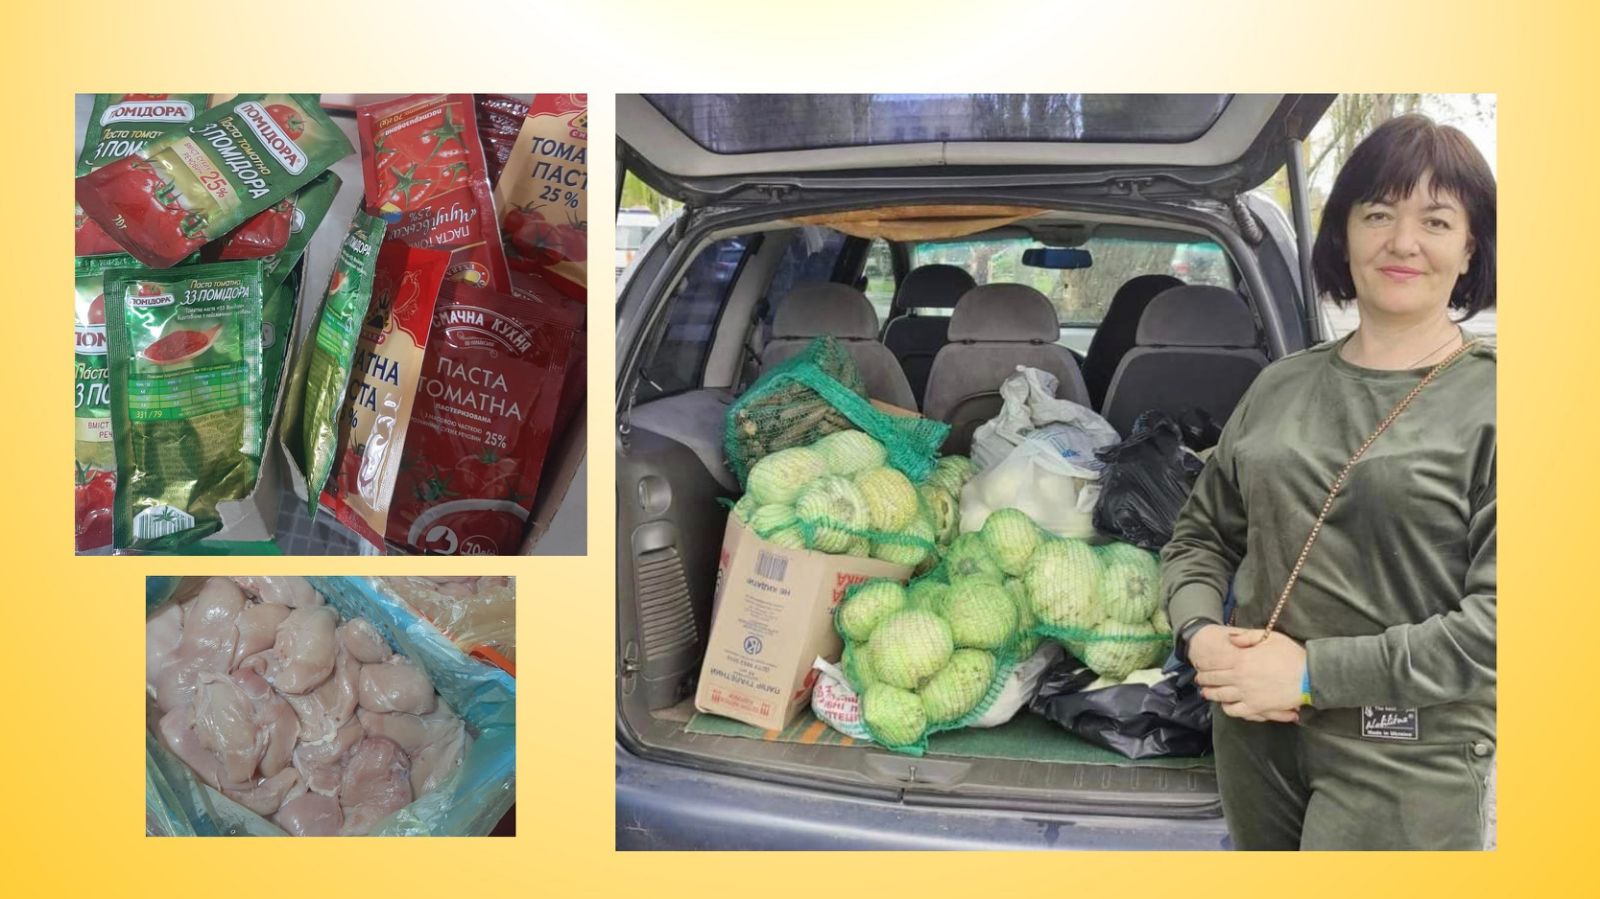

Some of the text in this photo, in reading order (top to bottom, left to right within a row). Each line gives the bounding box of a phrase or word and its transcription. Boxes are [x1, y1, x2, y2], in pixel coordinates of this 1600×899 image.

[241, 104, 299, 167] ПОМІДОРА
[202, 129, 270, 199] ПОМІДОРА
[531, 136, 587, 164] ТОМА
[200, 171, 228, 198] 25%
[539, 185, 561, 202] 25
[435, 225, 470, 244] ПАСТА
[197, 286, 250, 302] ПОМІДОРА
[432, 310, 532, 353] СМАЧНА КУХНЯ
[437, 357, 508, 392] ПАСТА
[418, 375, 522, 421] ТОМАТНА
[484, 431, 507, 449] 25%
